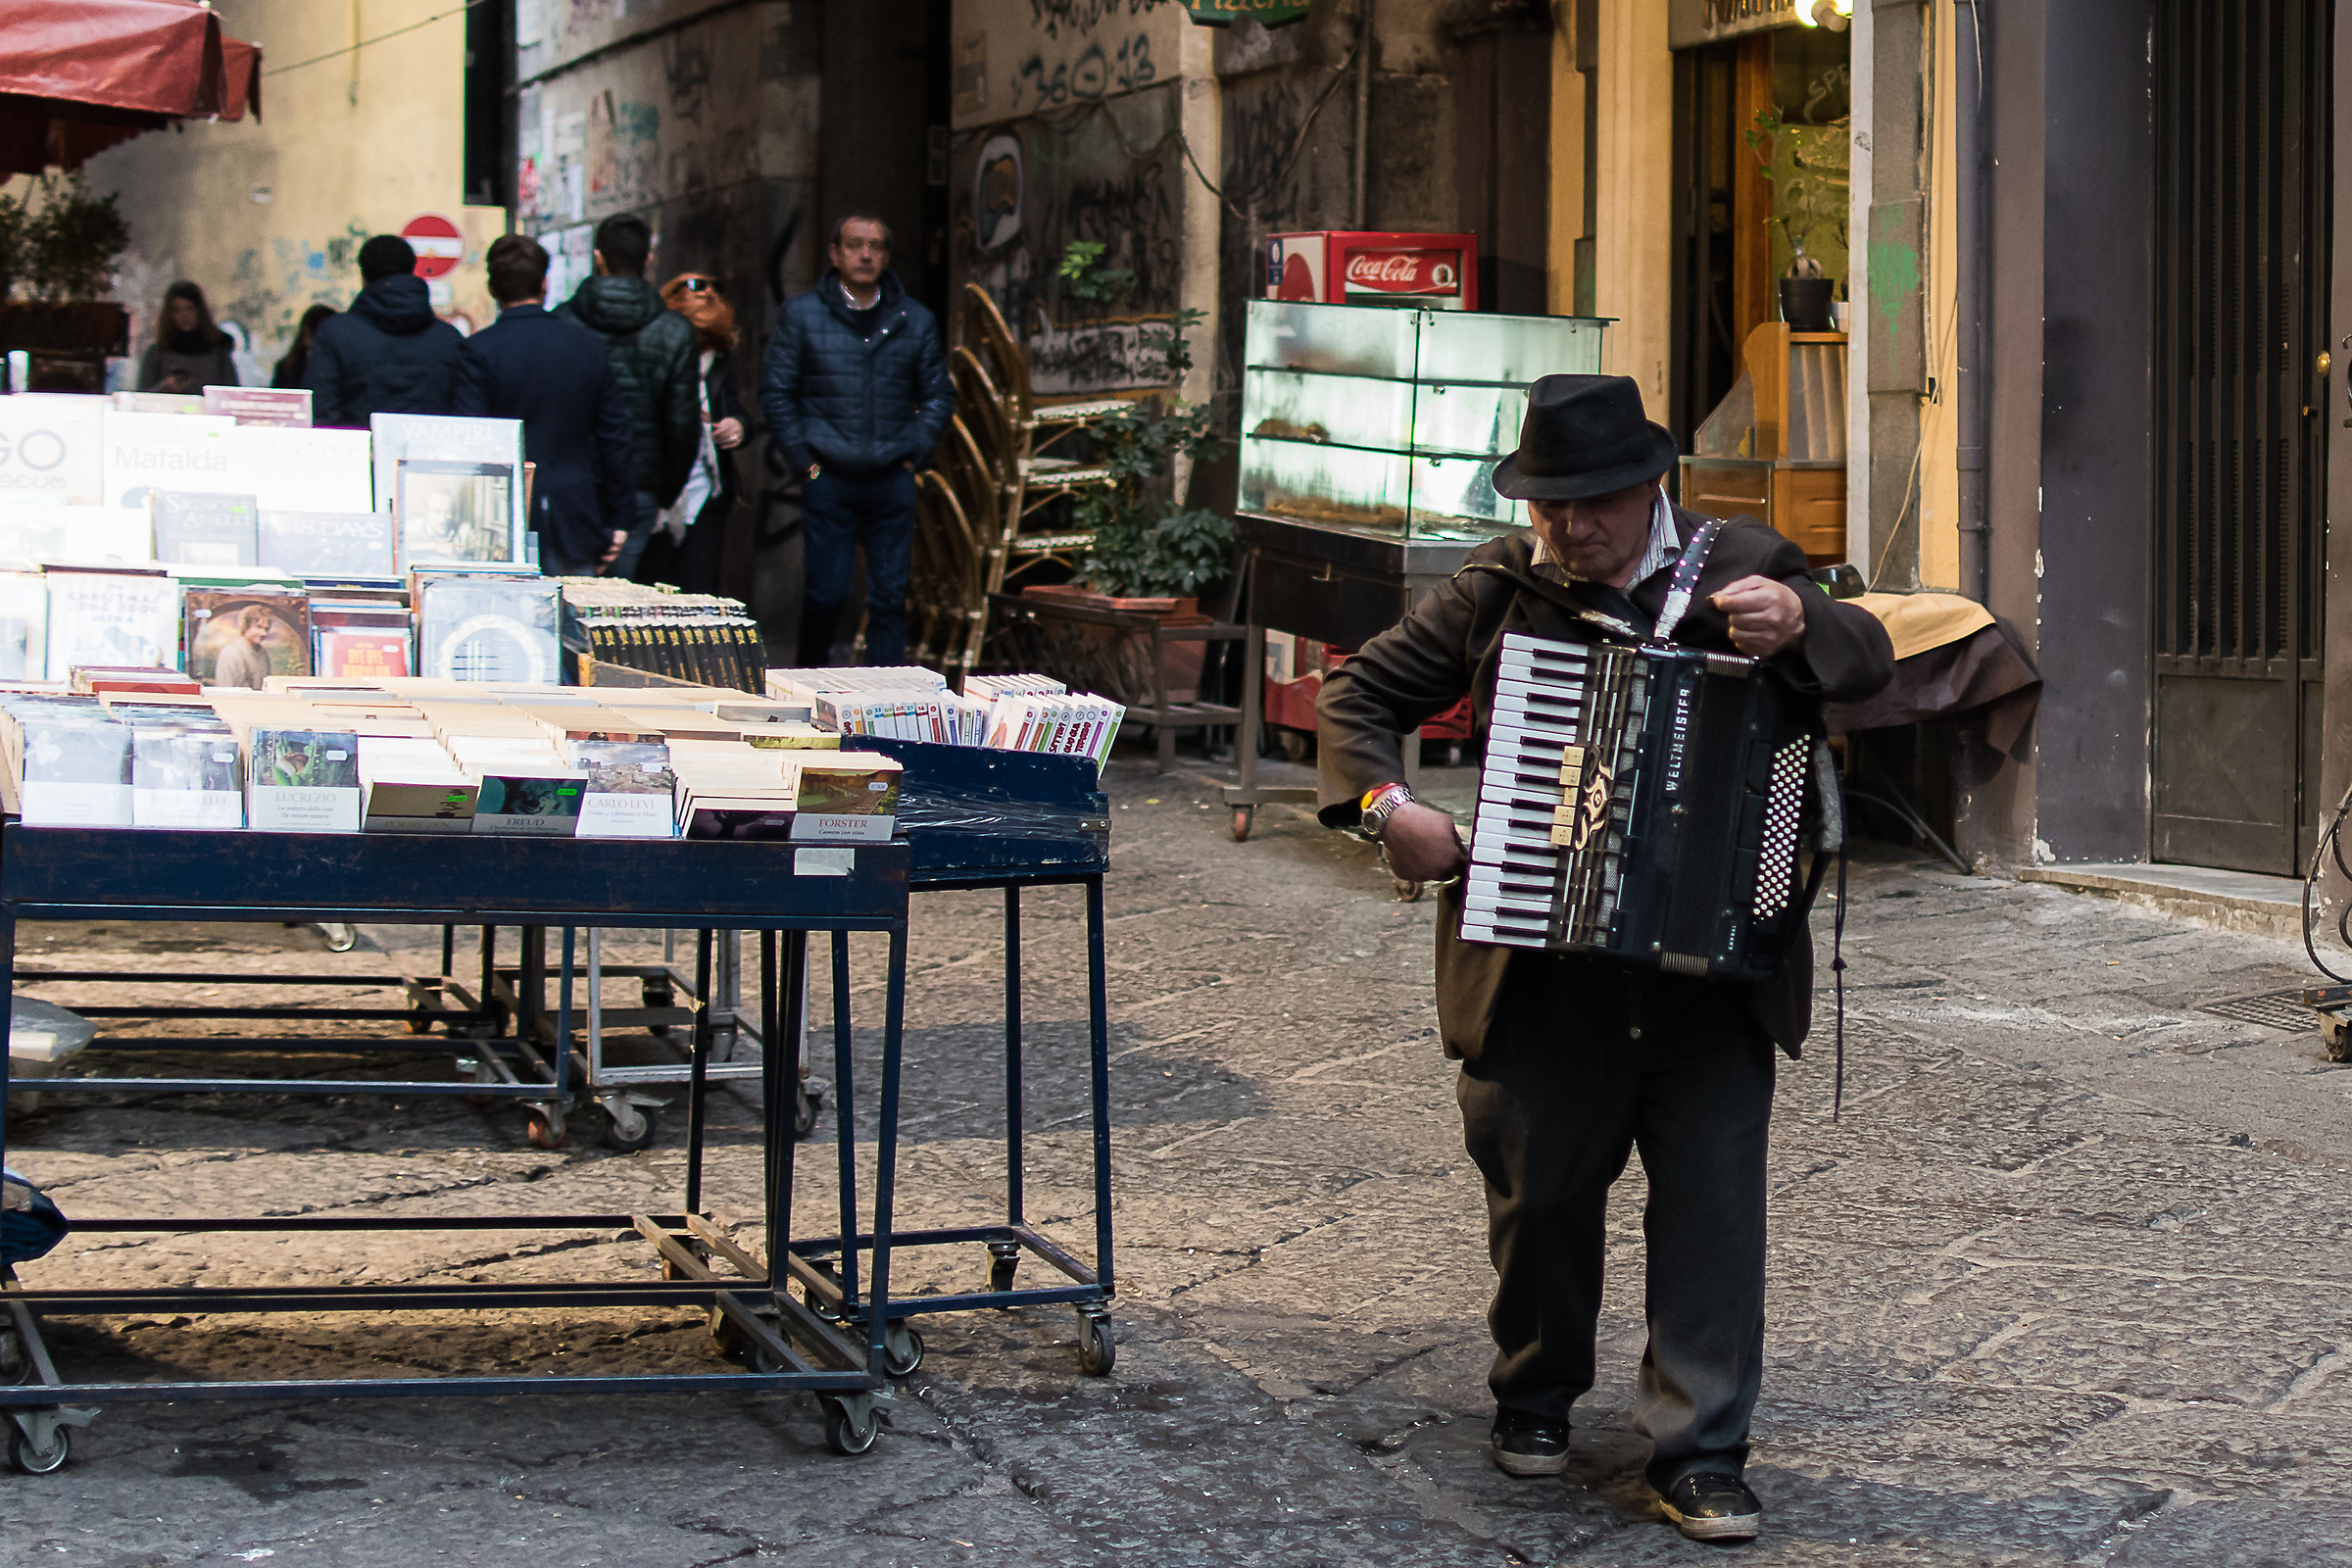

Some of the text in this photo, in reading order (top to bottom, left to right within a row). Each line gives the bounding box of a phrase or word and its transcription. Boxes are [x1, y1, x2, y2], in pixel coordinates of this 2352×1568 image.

[114, 446, 227, 471] Mafalda
[182, 512, 251, 527] ANELLI
[319, 520, 384, 538] DAYS
[1665, 688, 1690, 792] WELTMEISTER
[275, 791, 336, 803] LUCREZIO
[588, 799, 656, 809] CARLO LEVI
[818, 818, 868, 828] FORSTER
